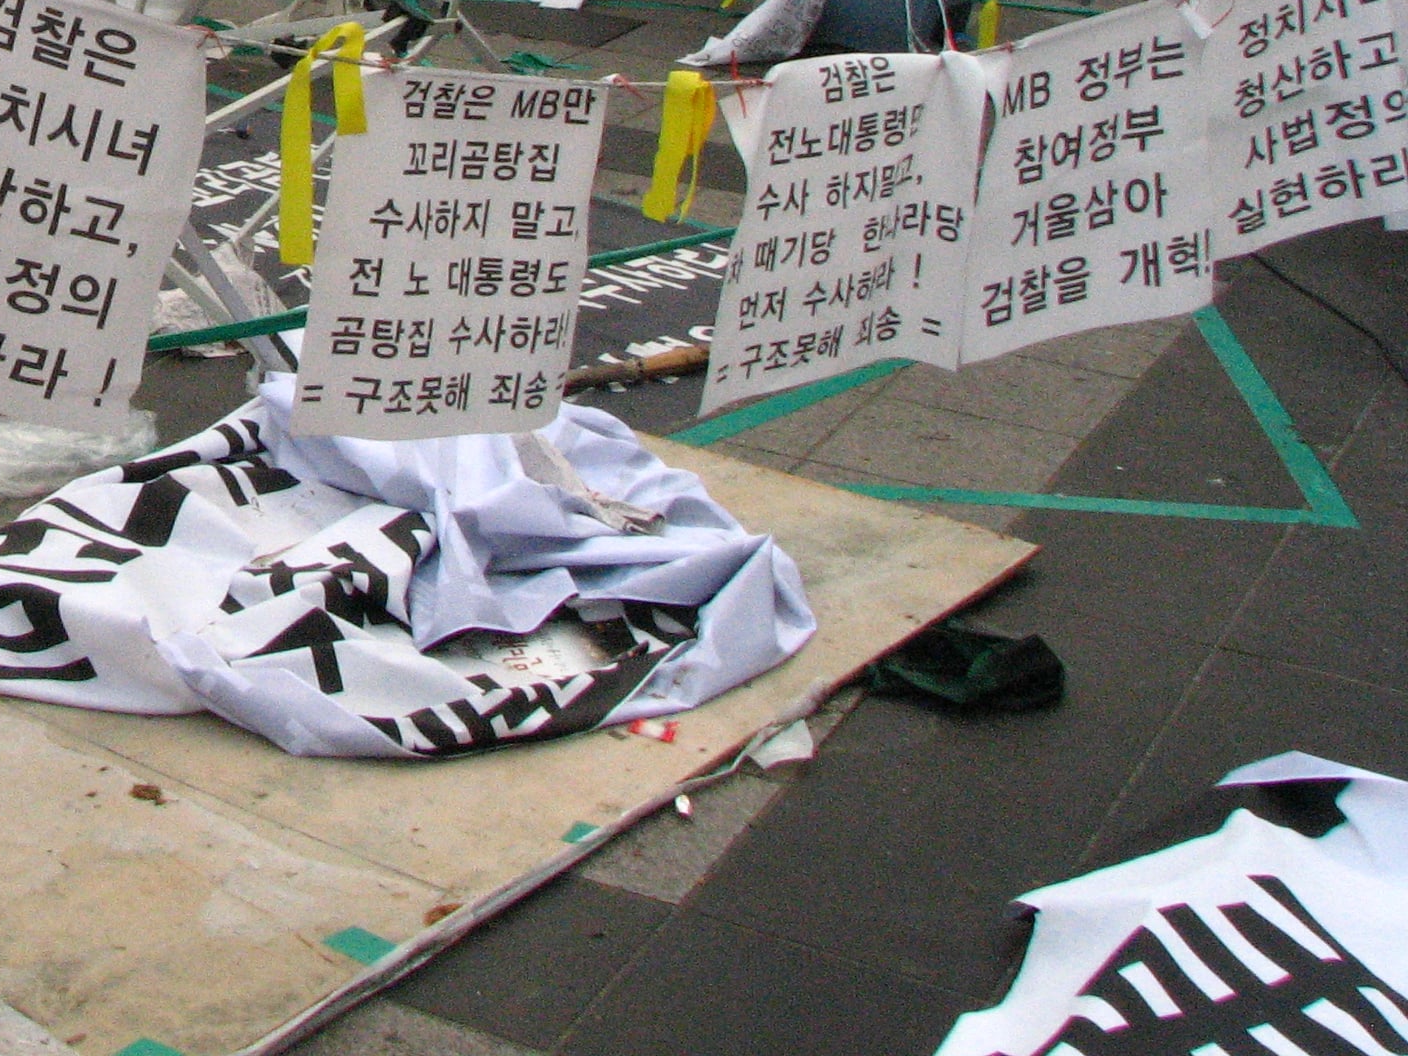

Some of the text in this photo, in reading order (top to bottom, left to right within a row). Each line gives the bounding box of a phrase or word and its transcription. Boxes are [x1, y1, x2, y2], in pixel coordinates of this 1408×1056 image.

[819, 55, 896, 105] 검찰은
[1002, 35, 1186, 119] MB 정부는
[1235, 30, 1399, 120] 청산하고
[402, 80, 595, 126] 검찰은 MB만
[402, 139, 560, 182] 꼬리곰탕집
[1013, 104, 1165, 186] 참여정부
[369, 198, 491, 240] 수사하지
[1010, 172, 1169, 248] 거울삼아
[348, 257, 383, 297] 전
[403, 262, 430, 297] 노
[447, 257, 570, 297] 대통령도
[980, 255, 1092, 329] 검찰을
[738, 285, 787, 331] 먼저
[330, 315, 435, 359] 곰탕집
[740, 325, 844, 379] 구조못해
[345, 373, 471, 416] 구조못해
[488, 372, 547, 412] 죄송
